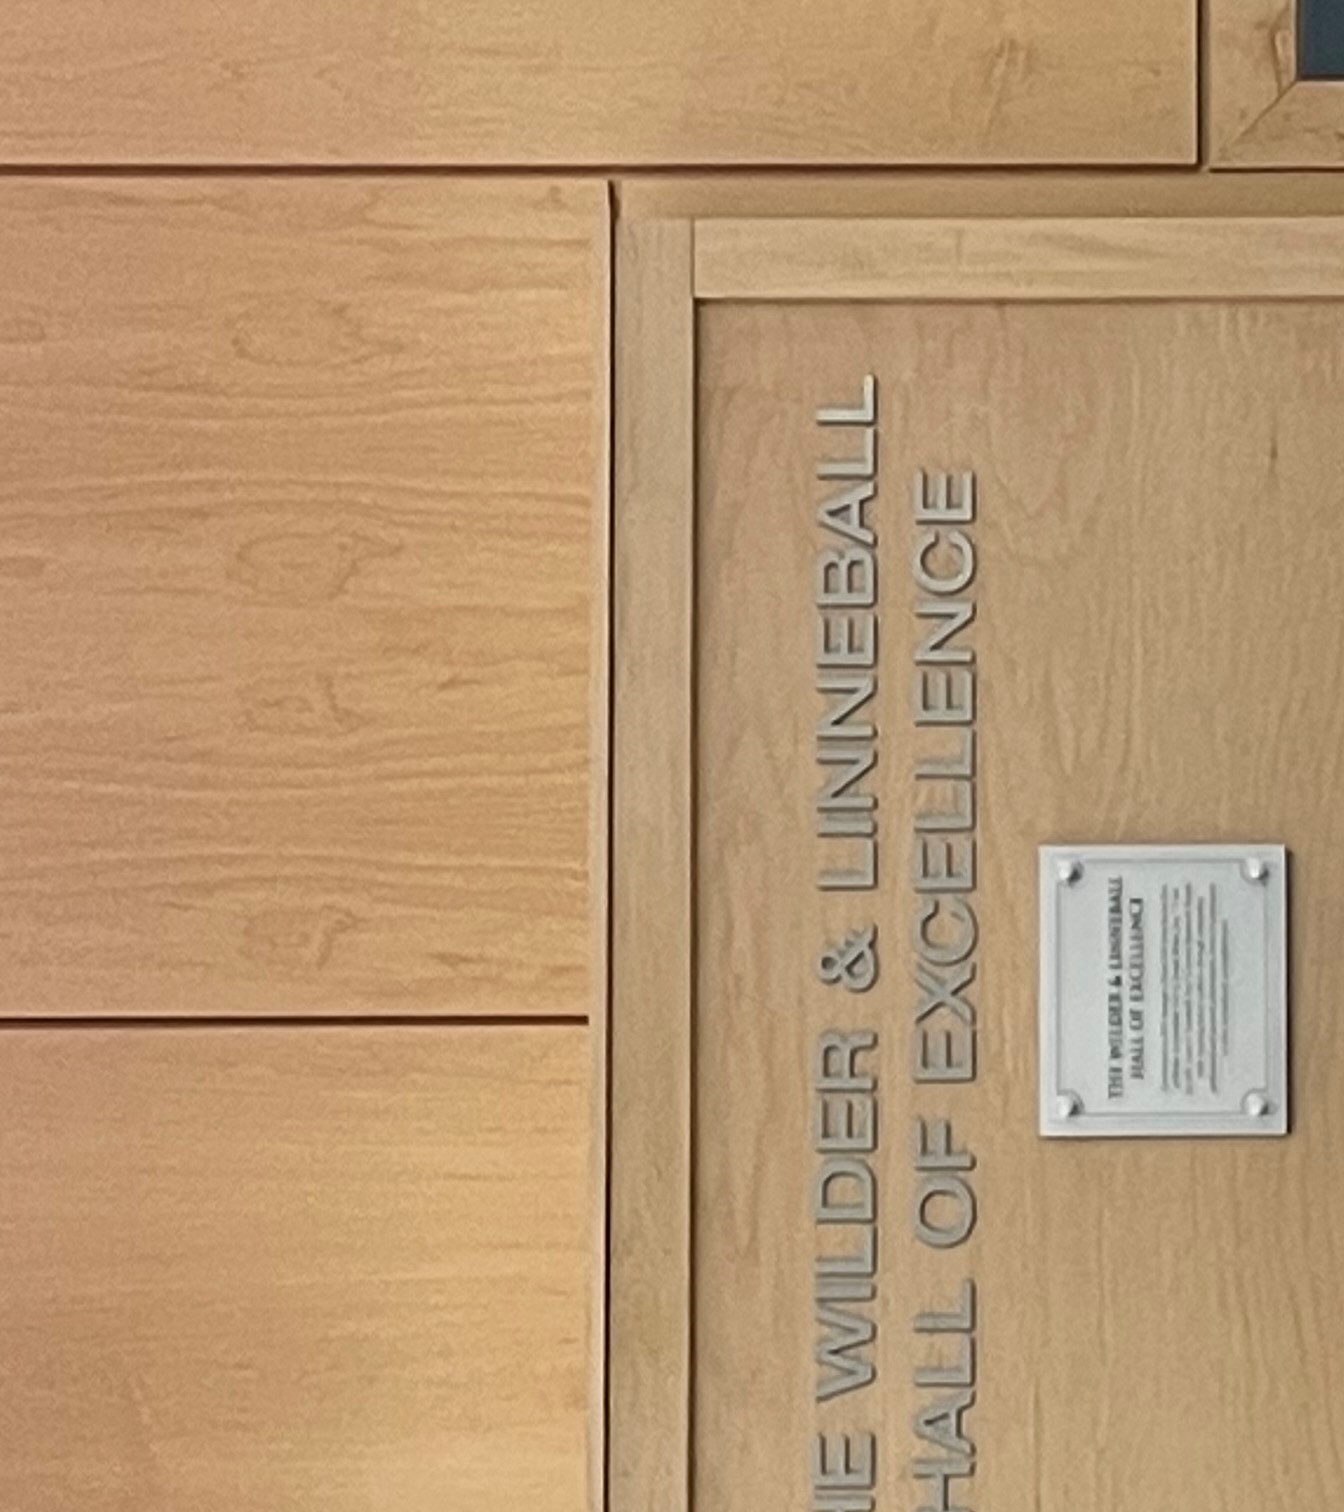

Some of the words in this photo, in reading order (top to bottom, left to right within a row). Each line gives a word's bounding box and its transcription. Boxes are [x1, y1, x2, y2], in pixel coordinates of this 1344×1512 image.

[815, 374, 878, 891] LINNEBALL
[912, 469, 977, 1083] EXCELLENCE
[816, 922, 878, 993] &
[1129, 1008, 1144, 1031] OF
[1129, 1036, 1144, 1080] HALL
[813, 1030, 877, 1402] WILDER
[911, 1117, 977, 1248] OF
